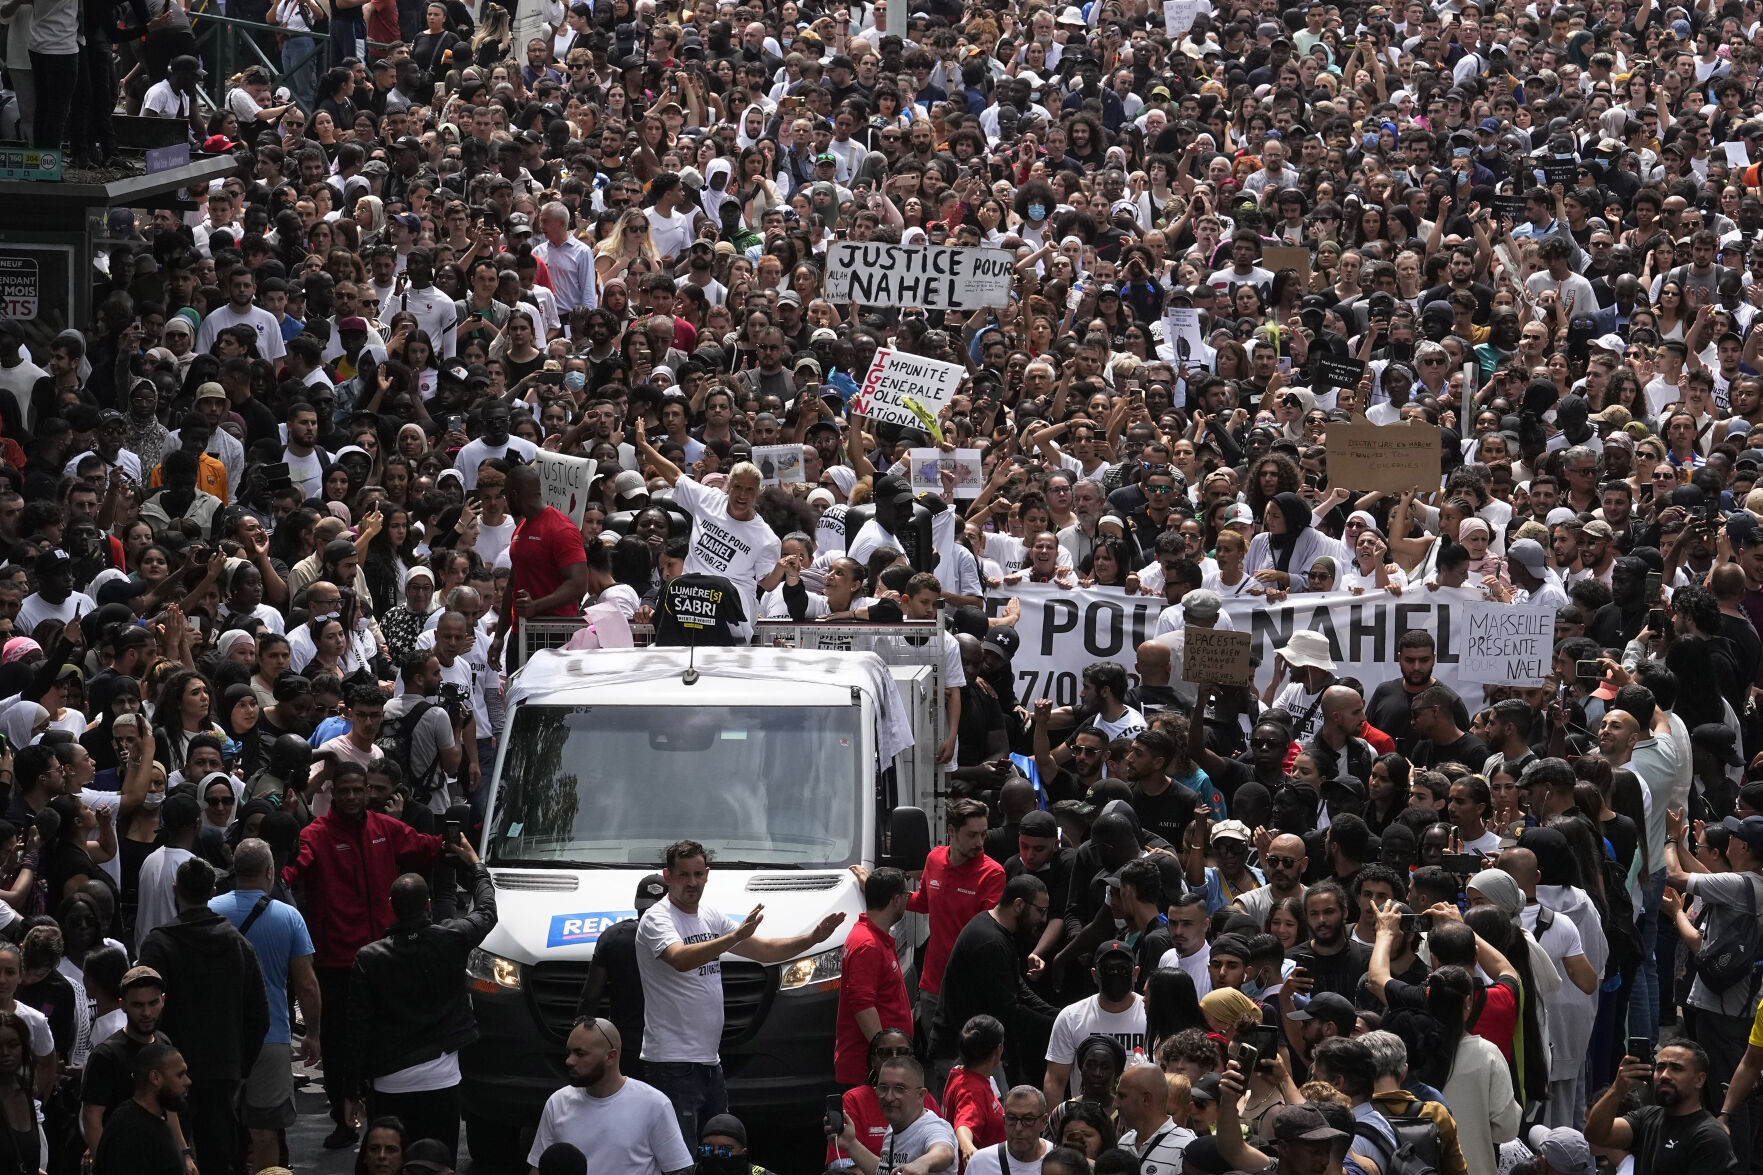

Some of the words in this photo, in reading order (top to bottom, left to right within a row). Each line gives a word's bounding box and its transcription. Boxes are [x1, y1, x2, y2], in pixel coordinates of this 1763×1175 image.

[43, 158, 55, 166] BUS
[0, 260, 23, 268] NEUF
[972, 257, 1013, 278] POUR
[827, 270, 848, 281] ALLAH
[4, 286, 36, 296] MOIS
[833, 282, 840, 291] Y
[847, 269, 964, 308] NAHEL
[866, 368, 944, 401] GÉNÉRALE
[548, 484, 567, 497] POUR
[700, 519, 730, 541] JUSTICE
[727, 535, 751, 556] POUR
[698, 534, 733, 562] NAHEL
[694, 545, 728, 573] 27/06/23
[1005, 560, 1021, 569] JUST
[674, 597, 717, 617] SABRI
[1251, 602, 1460, 664] NAHEL
[1469, 612, 1551, 637] MARSEILLE
[1190, 646, 1217, 655] DEPUIS
[1220, 647, 1240, 657] RIEN
[1468, 634, 1539, 657] PRÉSENTE
[470, 662, 486, 672] OUR
[1464, 657, 1497, 673] POUR
[1090, 1033, 1144, 1051] MA
